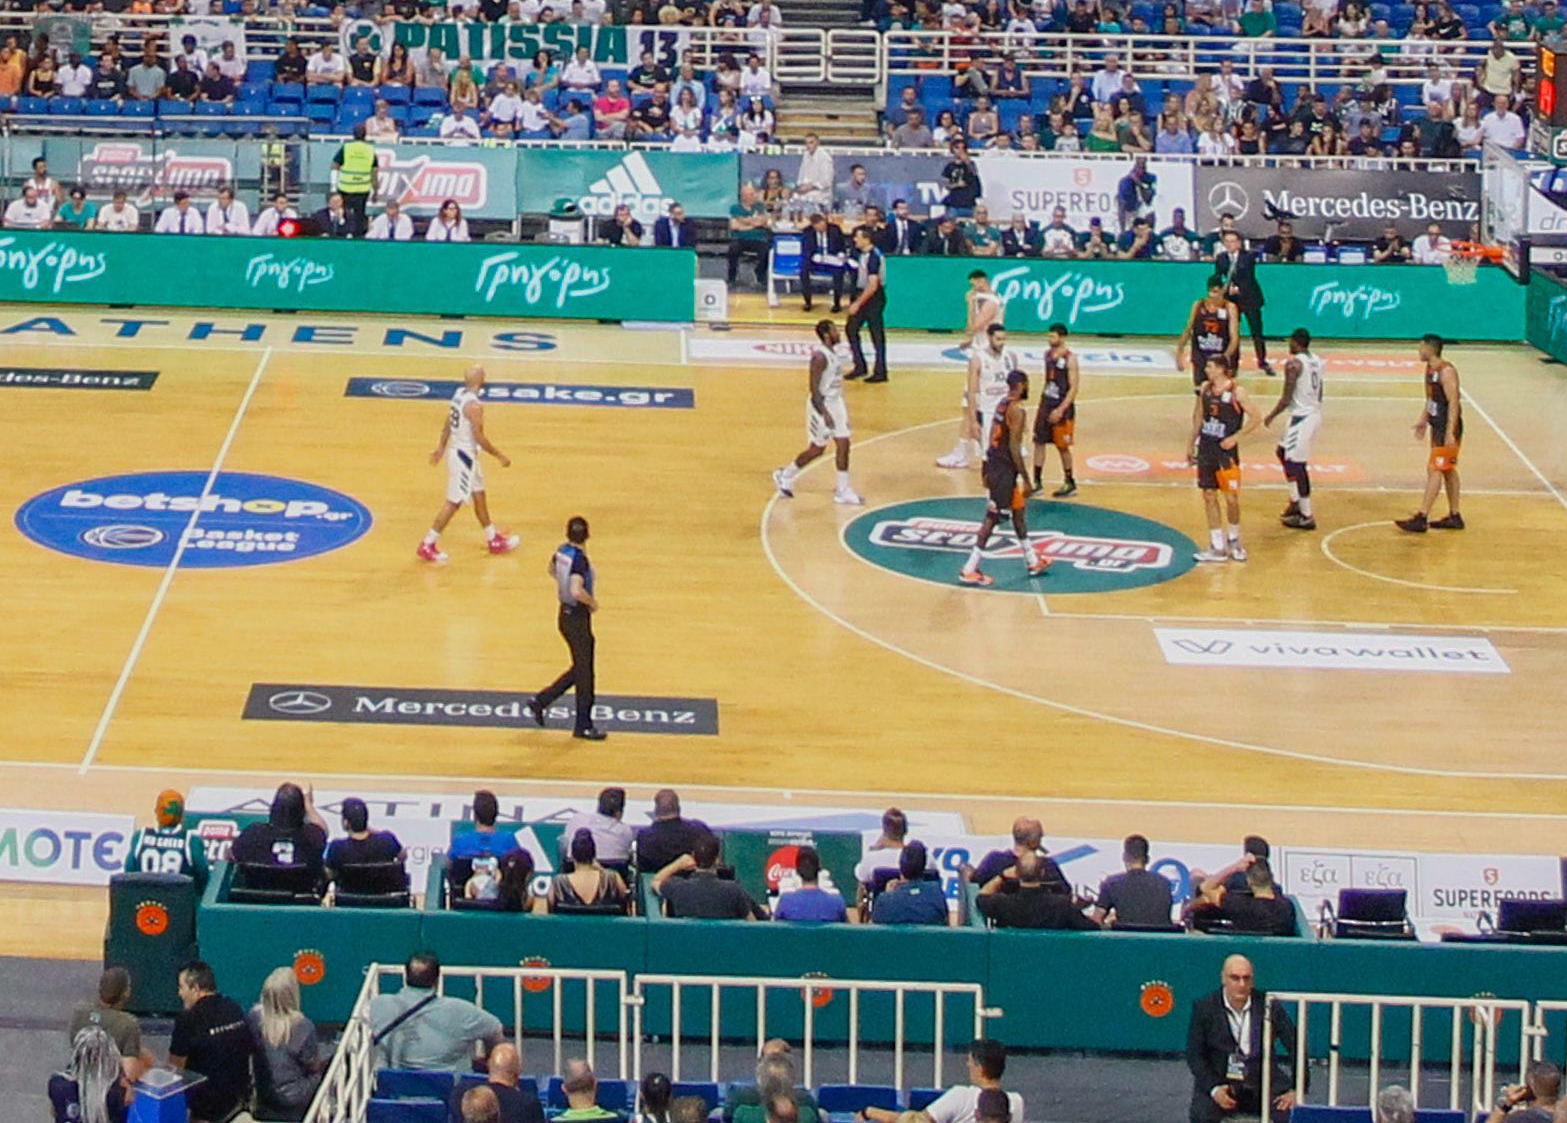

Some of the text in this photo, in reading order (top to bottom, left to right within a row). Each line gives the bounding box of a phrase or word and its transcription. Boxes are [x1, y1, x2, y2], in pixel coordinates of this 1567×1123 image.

[395, 22, 680, 68] PATISSIA 13
[1012, 189, 1118, 213] SUPERFO
[1262, 188, 1479, 222] Mercedes-Benz
[1, 316, 558, 352] ATHENS
[179, 538, 297, 553] League
[186, 528, 300, 543] Basket
